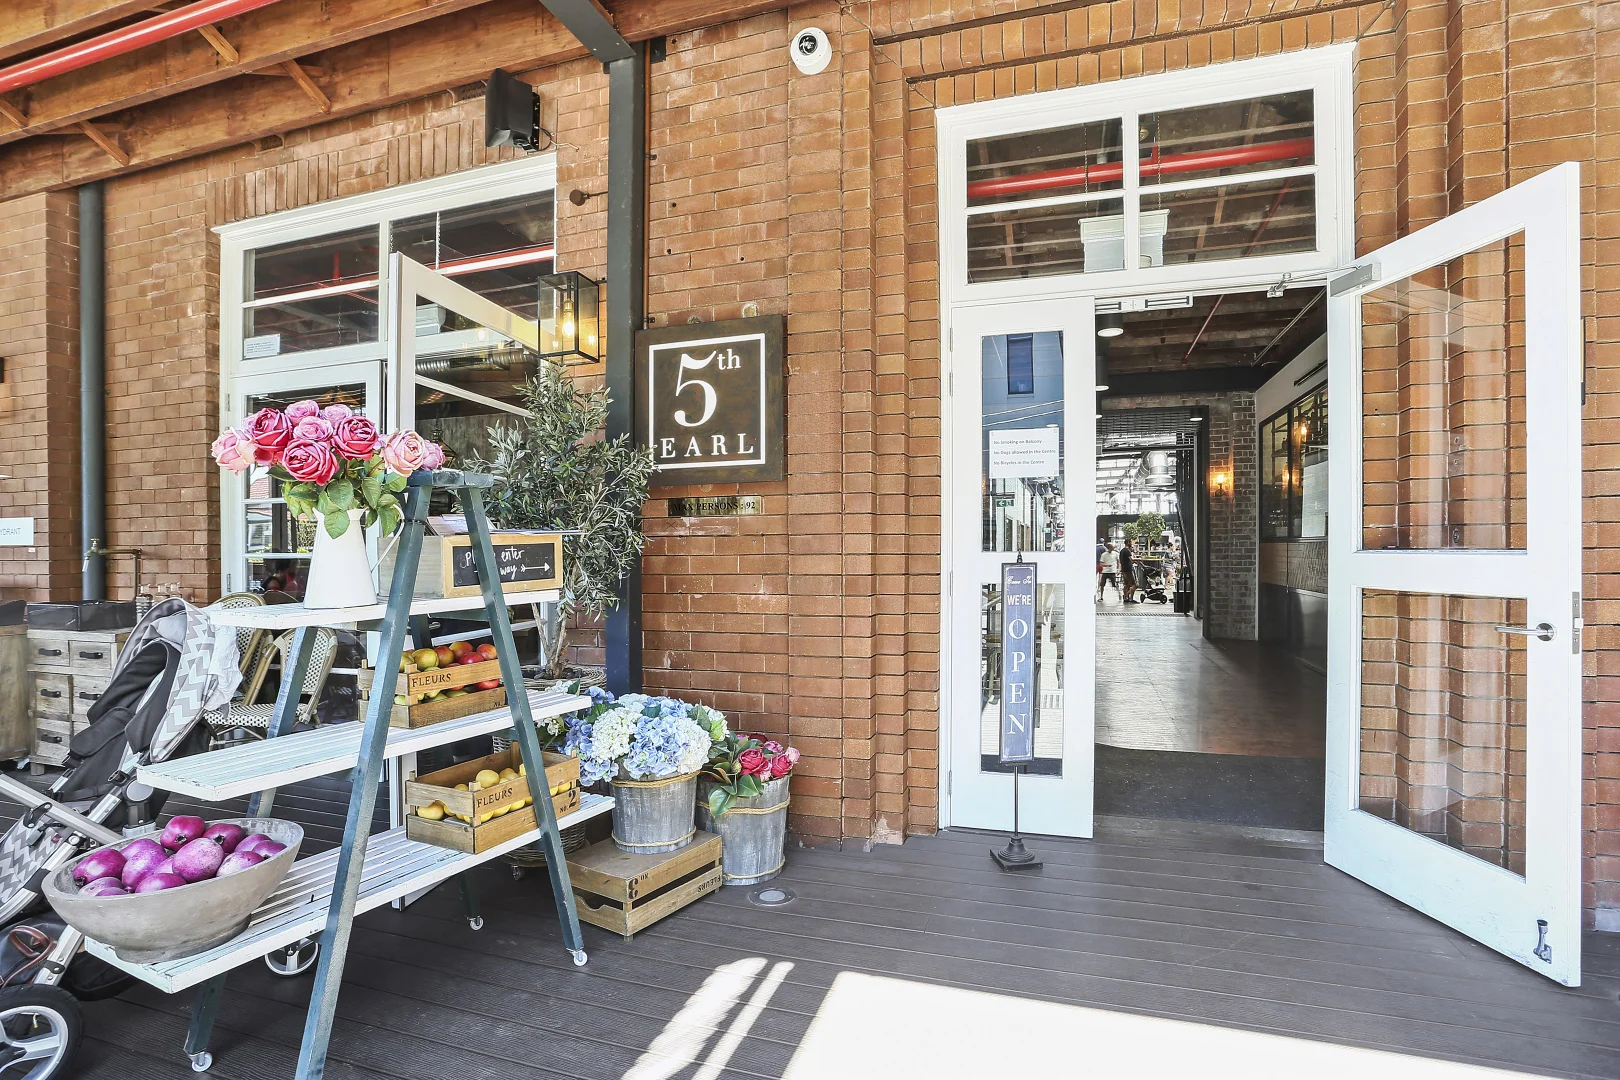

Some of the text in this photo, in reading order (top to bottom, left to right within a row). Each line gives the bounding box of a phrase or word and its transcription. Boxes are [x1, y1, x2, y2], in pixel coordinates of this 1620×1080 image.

[674, 348, 742, 427] 5th
[660, 433, 754, 458] EARL
[696, 502, 738, 511] PERSONS
[746, 501, 756, 510] 92
[501, 546, 525, 563] enter
[499, 565, 518, 580] way
[1007, 593, 1032, 606] WE'RE
[411, 673, 452, 688] FLEURS
[1007, 618, 1028, 734] OPEN
[476, 787, 513, 808] FLEURS
[568, 789, 577, 808] 2
[628, 878, 638, 899] 3
[697, 874, 721, 893] FLEURS
